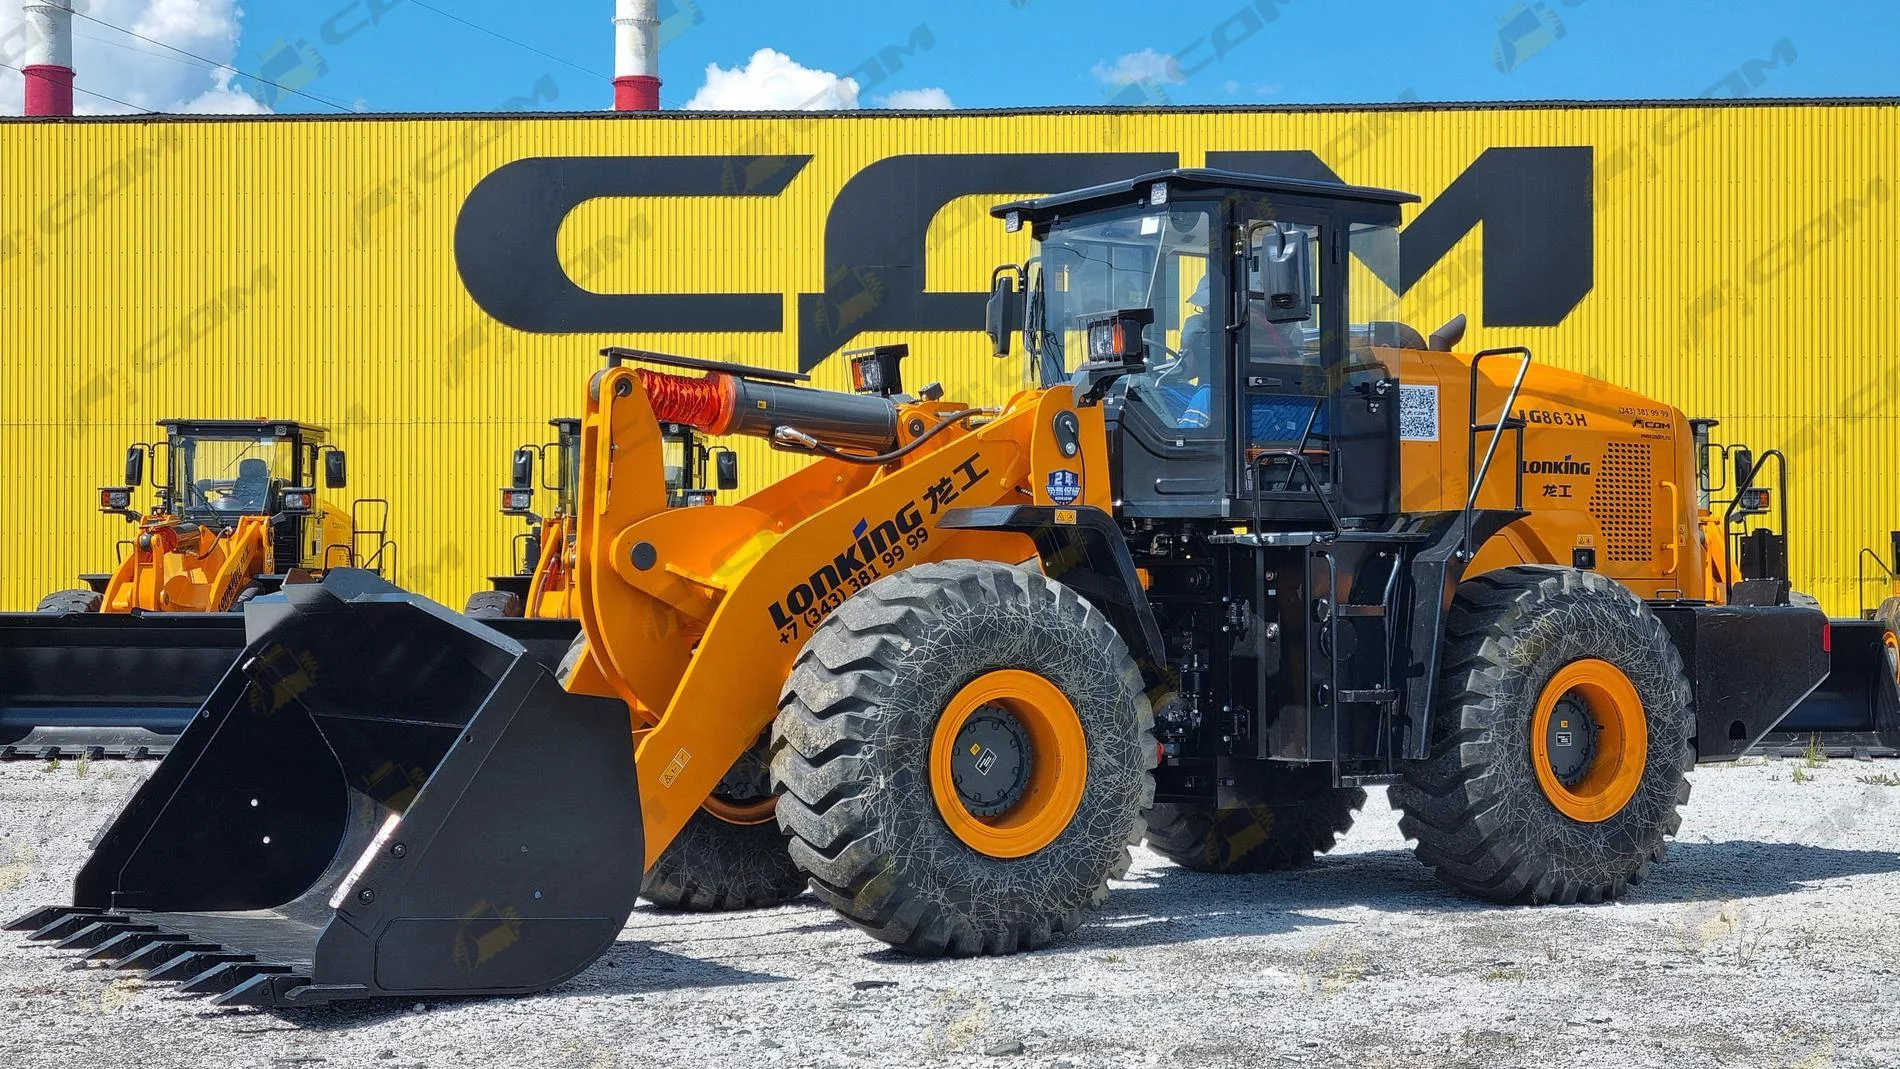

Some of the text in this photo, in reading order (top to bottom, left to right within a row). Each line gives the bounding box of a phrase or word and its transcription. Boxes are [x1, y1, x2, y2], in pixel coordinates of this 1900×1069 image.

[921, 451, 990, 515] 龙工
[1542, 484, 1572, 498] 龙工
[778, 527, 930, 647] +7 (343) 381 99 99
